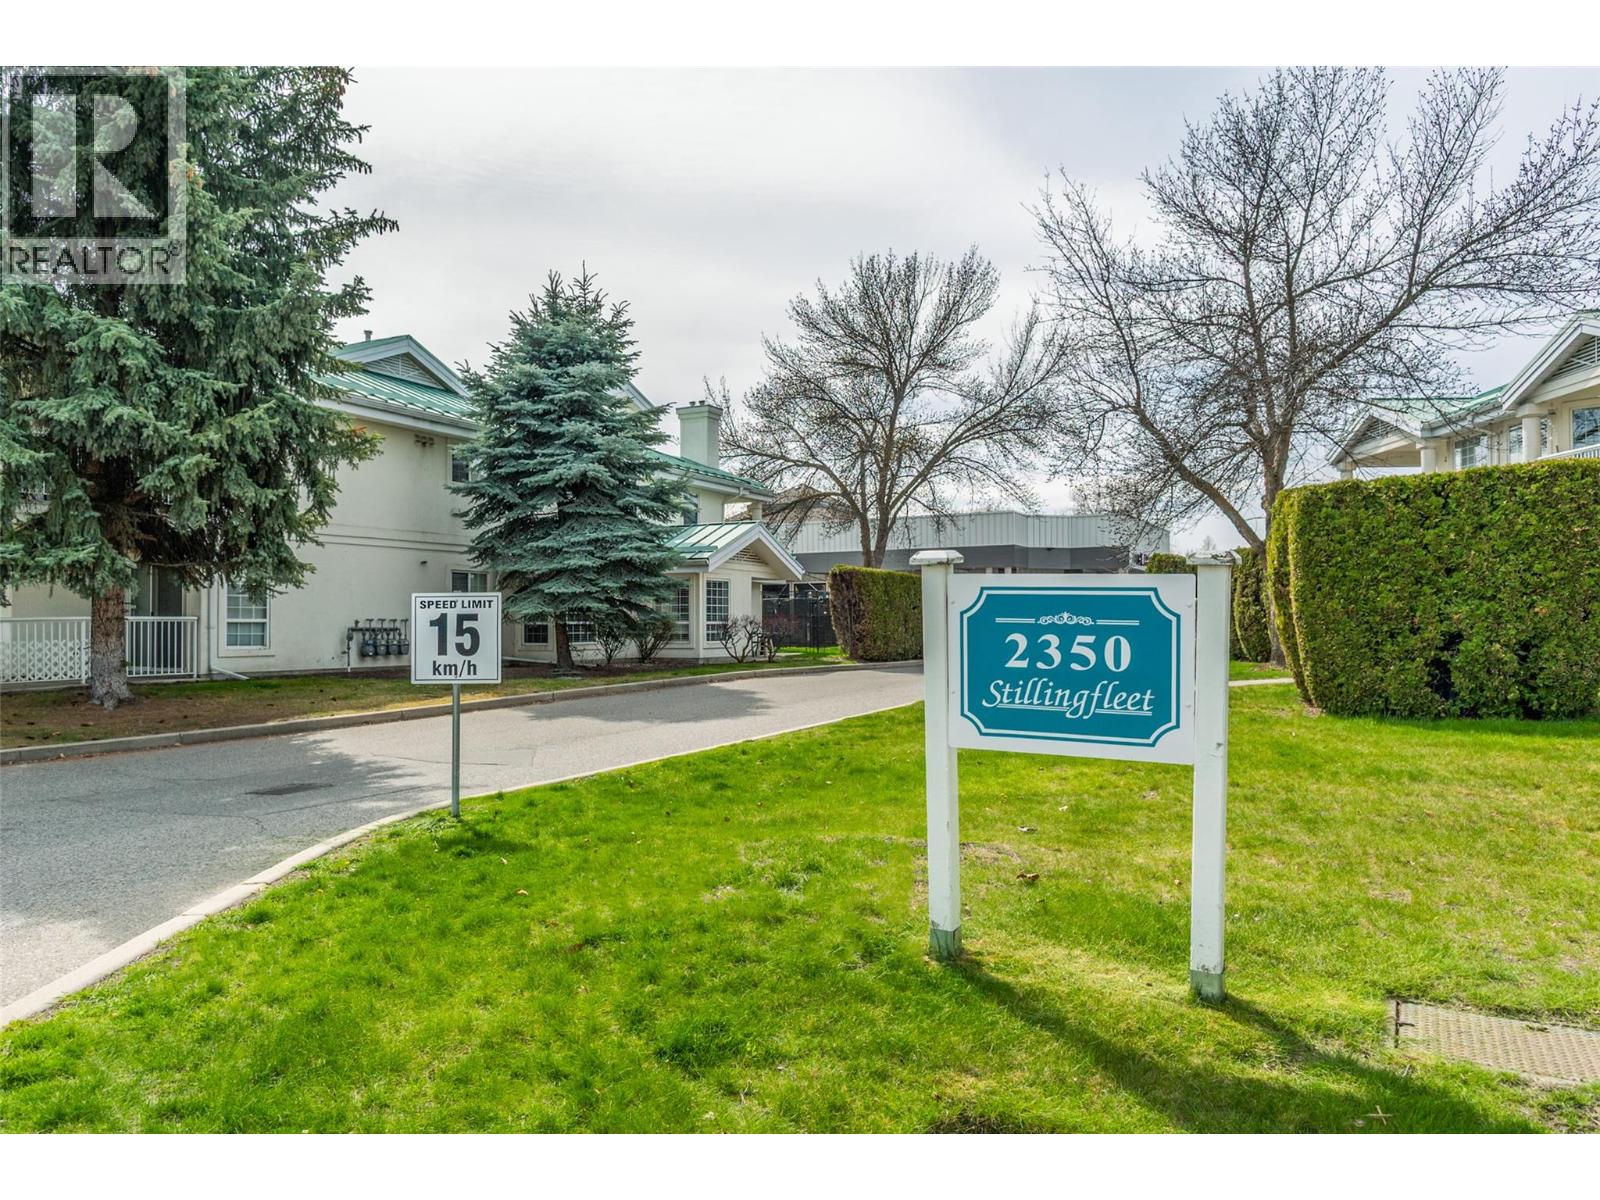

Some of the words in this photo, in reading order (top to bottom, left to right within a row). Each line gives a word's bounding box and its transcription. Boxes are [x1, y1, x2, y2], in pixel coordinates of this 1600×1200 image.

[419, 600, 458, 609] SPEED
[461, 599, 494, 609] LIMIT
[429, 612, 481, 657] 15
[1004, 633, 1132, 673] 2350
[432, 659, 477, 678] km/h
[981, 677, 1155, 720] Stillingfleet
